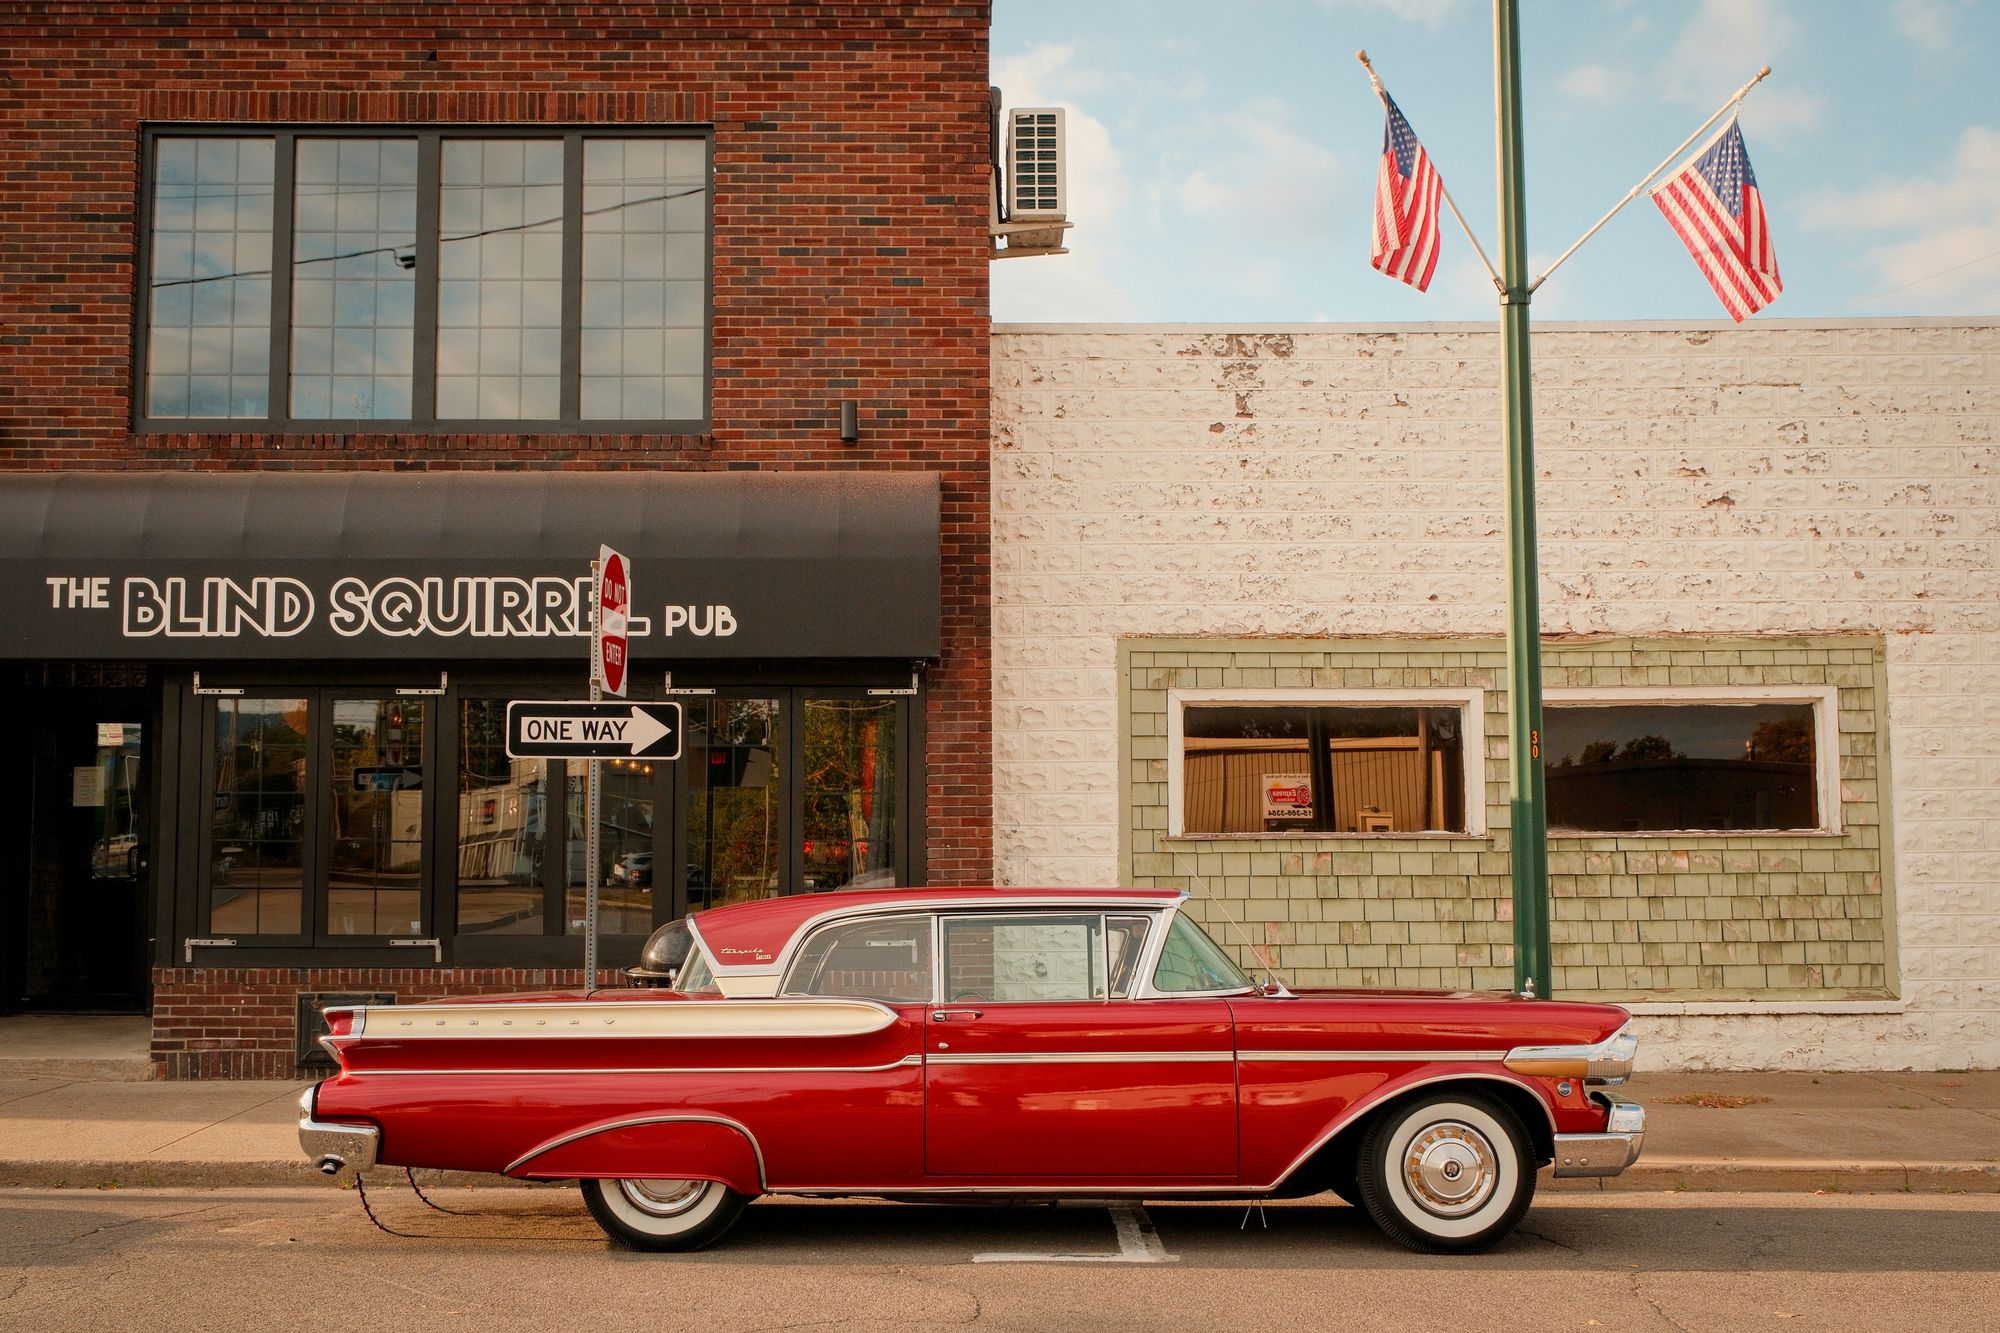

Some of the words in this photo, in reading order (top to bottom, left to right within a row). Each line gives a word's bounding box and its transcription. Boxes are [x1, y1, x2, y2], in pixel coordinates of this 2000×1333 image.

[604, 577, 613, 601] DO
[614, 583, 625, 606] NOT
[46, 577, 110, 609] THE
[122, 577, 315, 637] BLIND
[665, 605, 738, 637] PUB
[606, 640, 622, 667] ENTER
[527, 719, 573, 741] ONE
[582, 720, 629, 741] WAY
